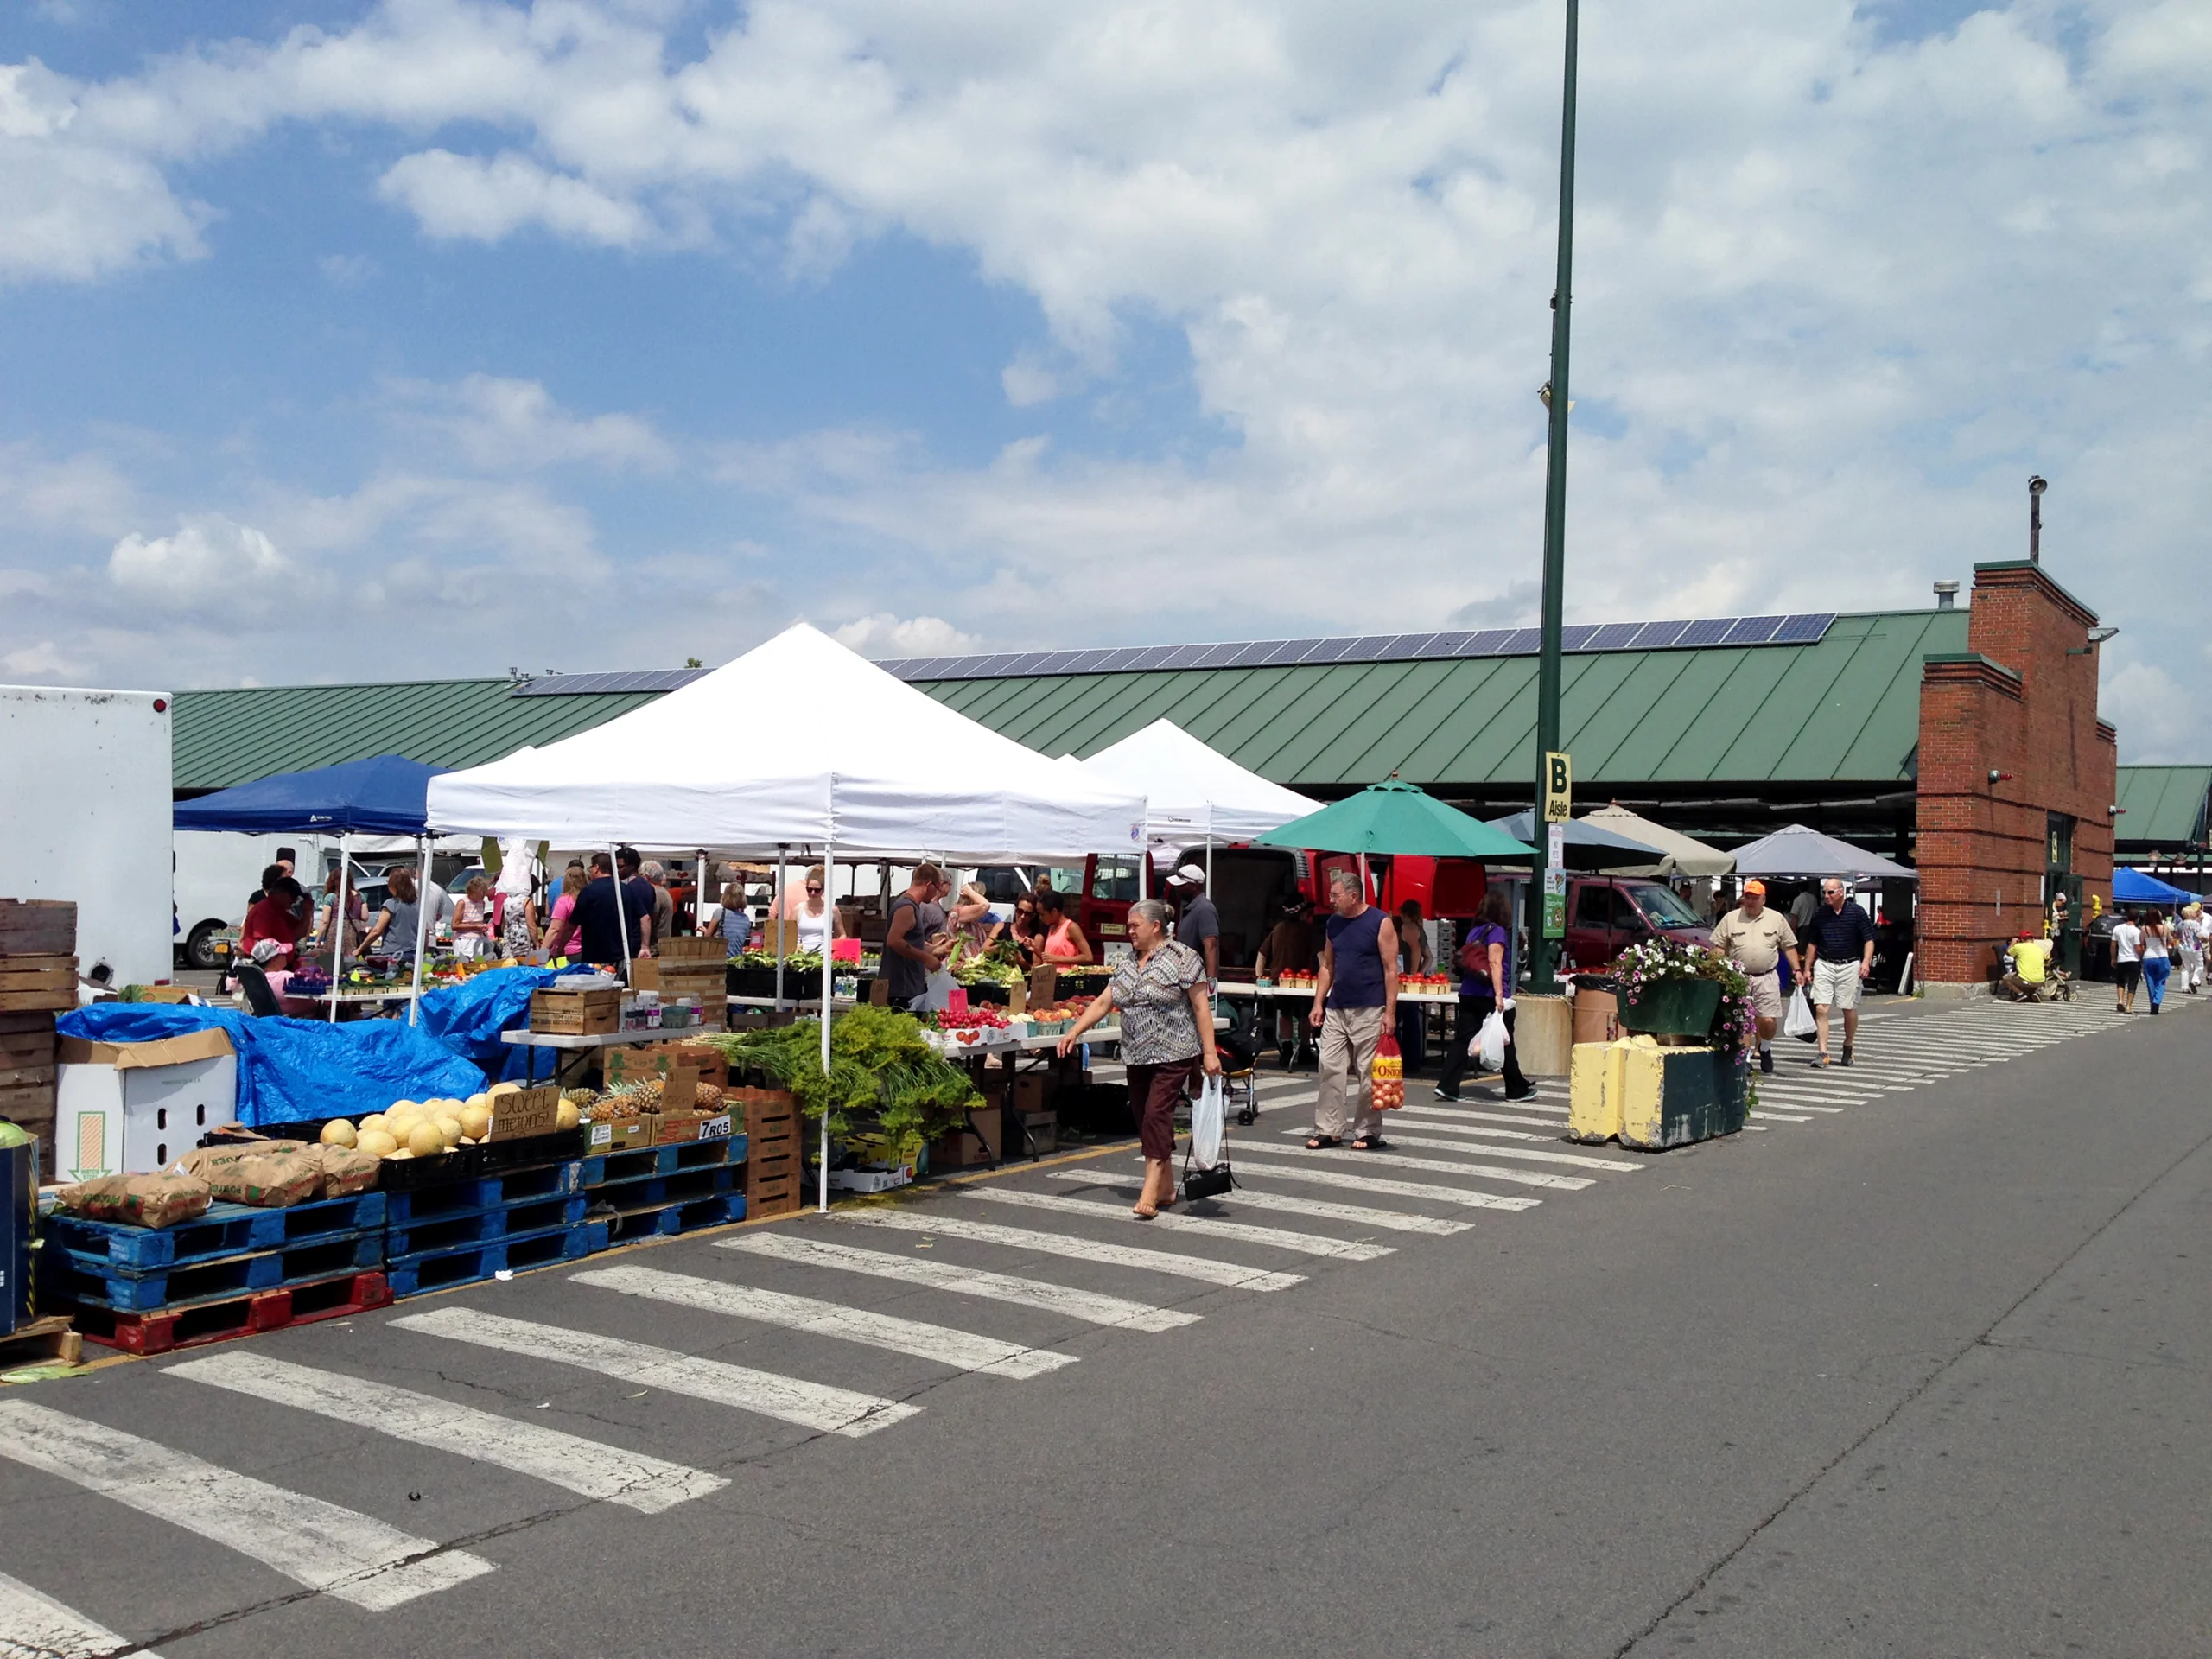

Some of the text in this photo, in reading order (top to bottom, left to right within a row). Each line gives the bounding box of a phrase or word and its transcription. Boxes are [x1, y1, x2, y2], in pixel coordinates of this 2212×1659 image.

[1551, 757, 1567, 794] B
[1548, 799, 1567, 817] Aisle
[500, 1089, 550, 1115] Sweet
[702, 1121, 729, 1138] 7R05
